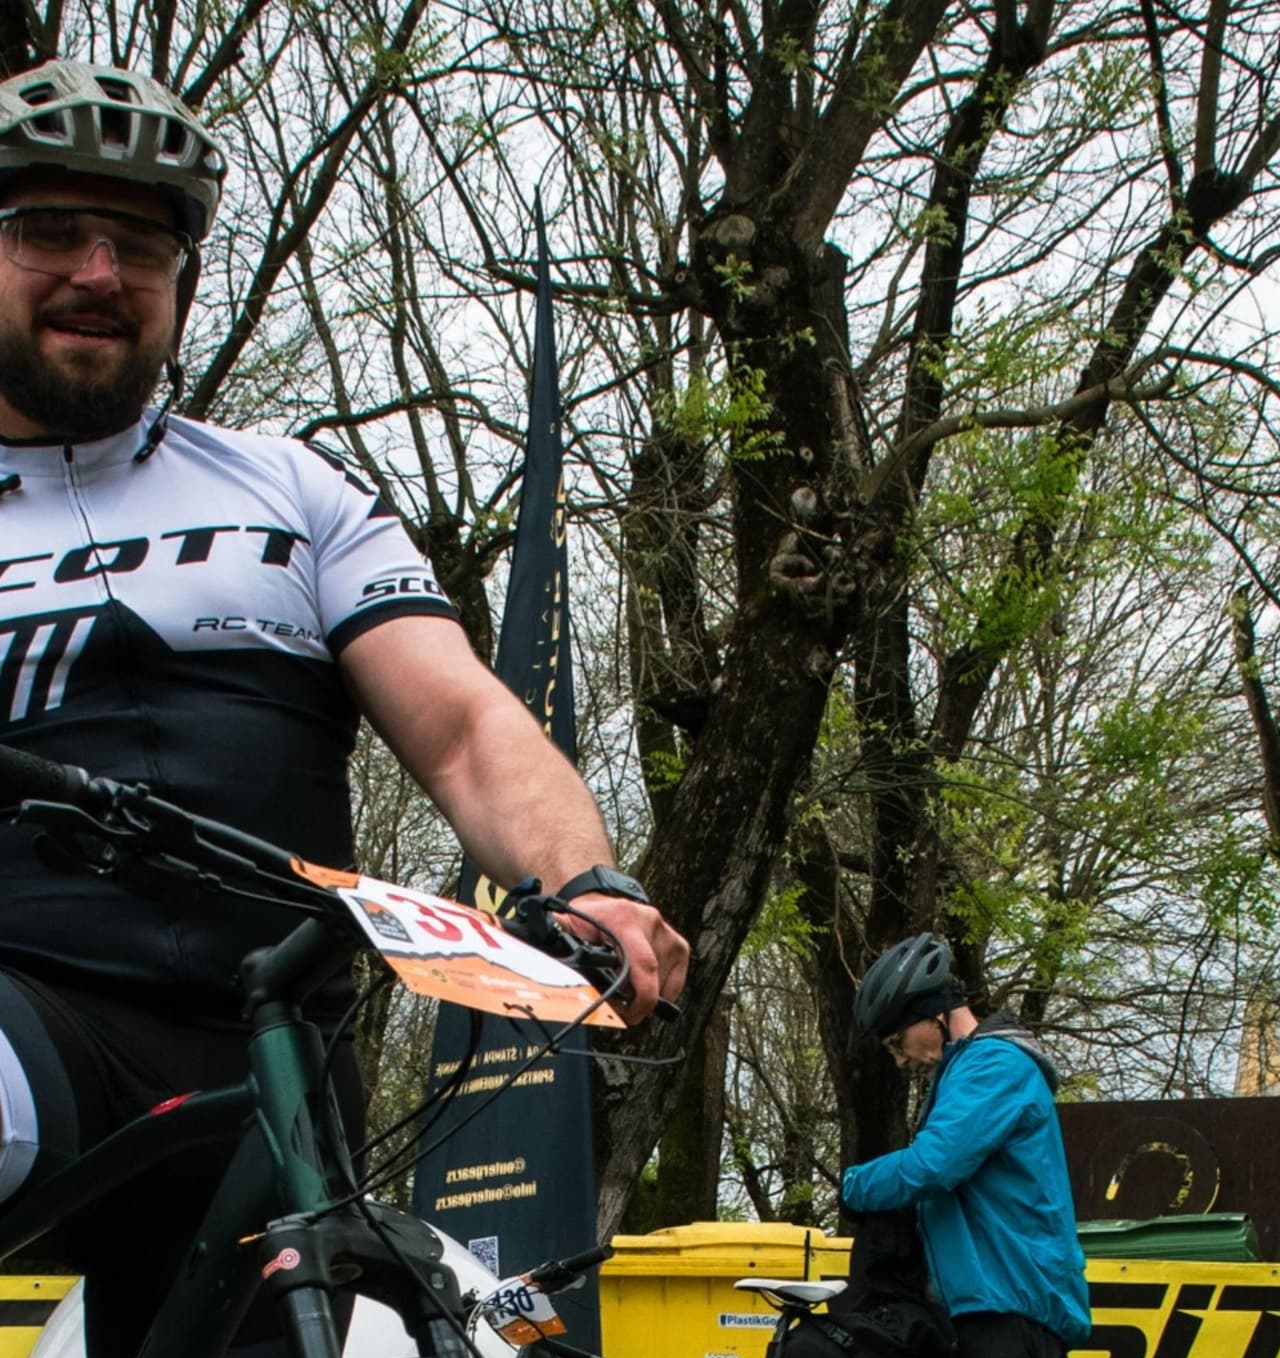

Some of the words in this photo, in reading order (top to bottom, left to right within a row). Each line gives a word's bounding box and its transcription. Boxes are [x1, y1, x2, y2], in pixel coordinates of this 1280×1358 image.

[355, 576, 444, 608] SCO
[192, 616, 248, 632] RC
[256, 617, 321, 643] TEAM
